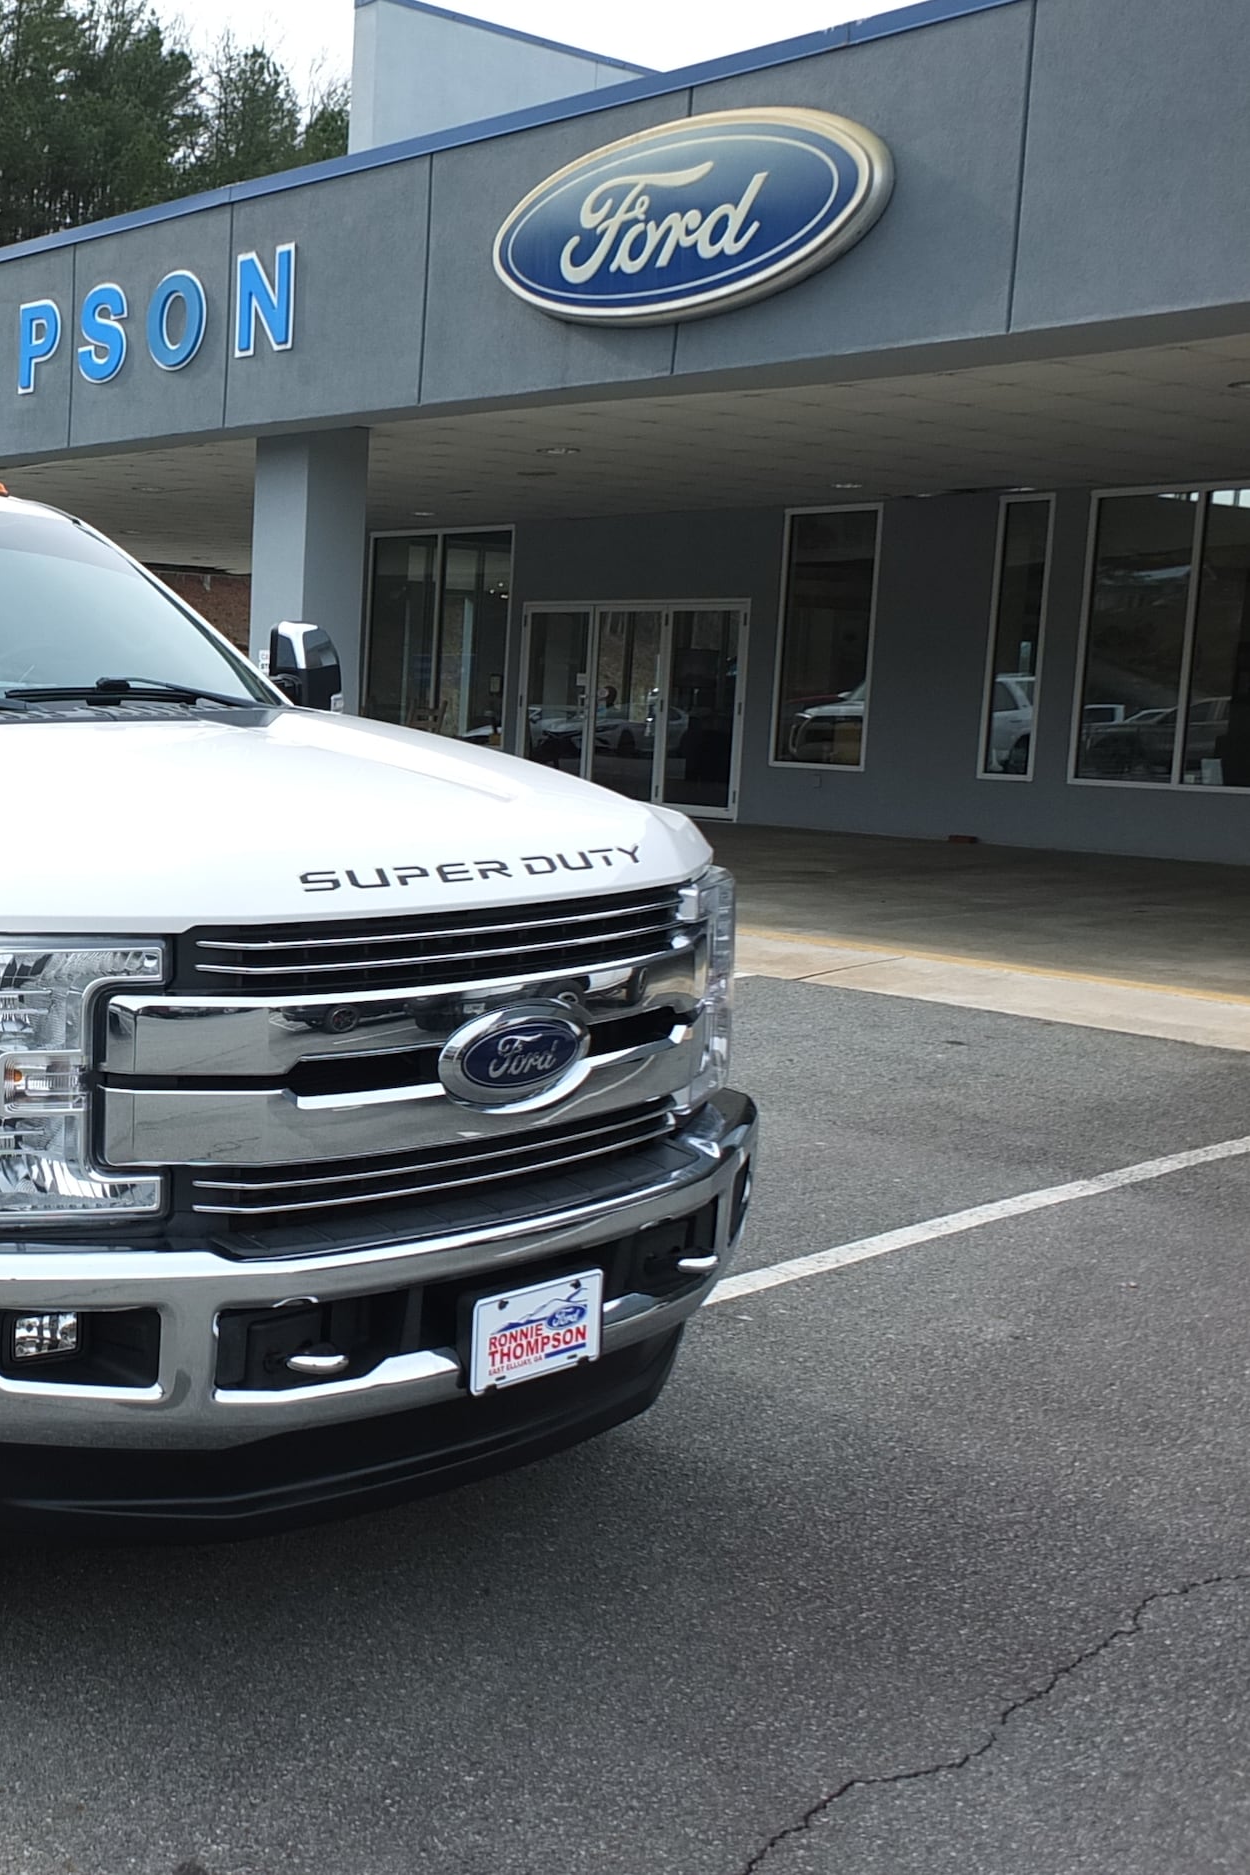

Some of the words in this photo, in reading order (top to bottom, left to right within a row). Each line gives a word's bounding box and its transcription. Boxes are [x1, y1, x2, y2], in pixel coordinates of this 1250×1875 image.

[560, 160, 769, 284] Ford
[299, 860, 513, 893] SUPER
[520, 844, 641, 876] DUTY
[488, 1033, 559, 1079] Ford
[489, 1323, 543, 1350] RONNIE
[552, 1308, 580, 1326] Ford
[488, 1325, 587, 1368] THOMPSON
